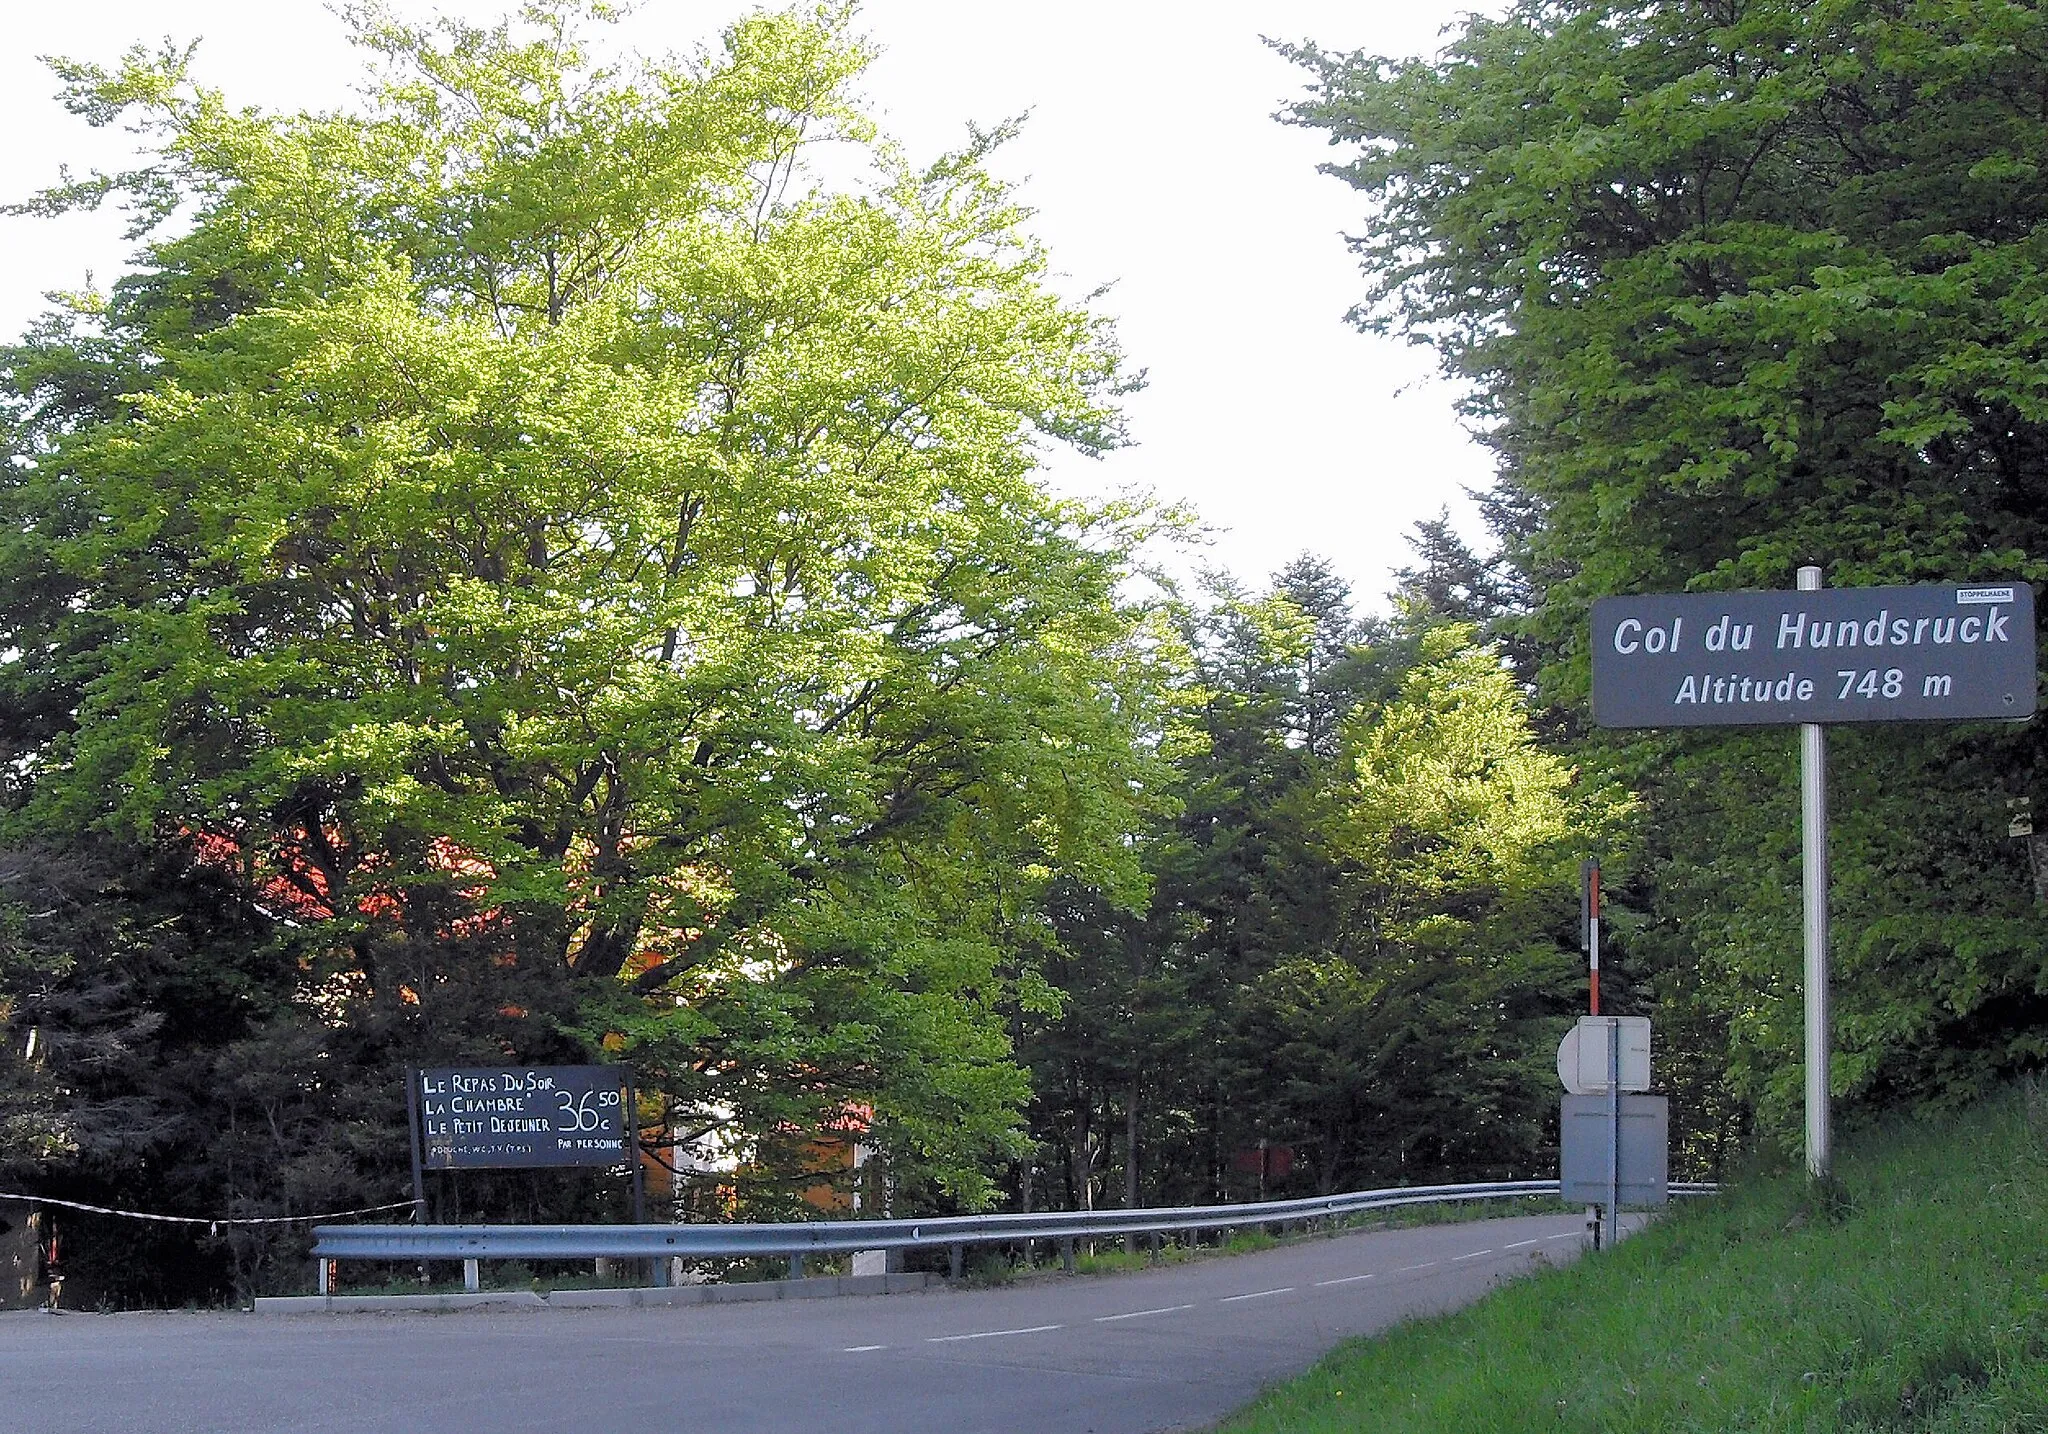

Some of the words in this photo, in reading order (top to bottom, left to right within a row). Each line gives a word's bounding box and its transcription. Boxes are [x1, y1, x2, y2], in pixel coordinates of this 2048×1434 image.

[1613, 616, 1682, 655] Col
[1705, 615, 1753, 652] du
[1776, 606, 2010, 650] Hundsruck
[1674, 672, 1814, 705] Altitude
[1837, 668, 1904, 701] 748
[1923, 673, 1952, 698] m
[451, 1096, 525, 1114] CHAMBRE
[491, 1116, 551, 1133] DEJEUNER
